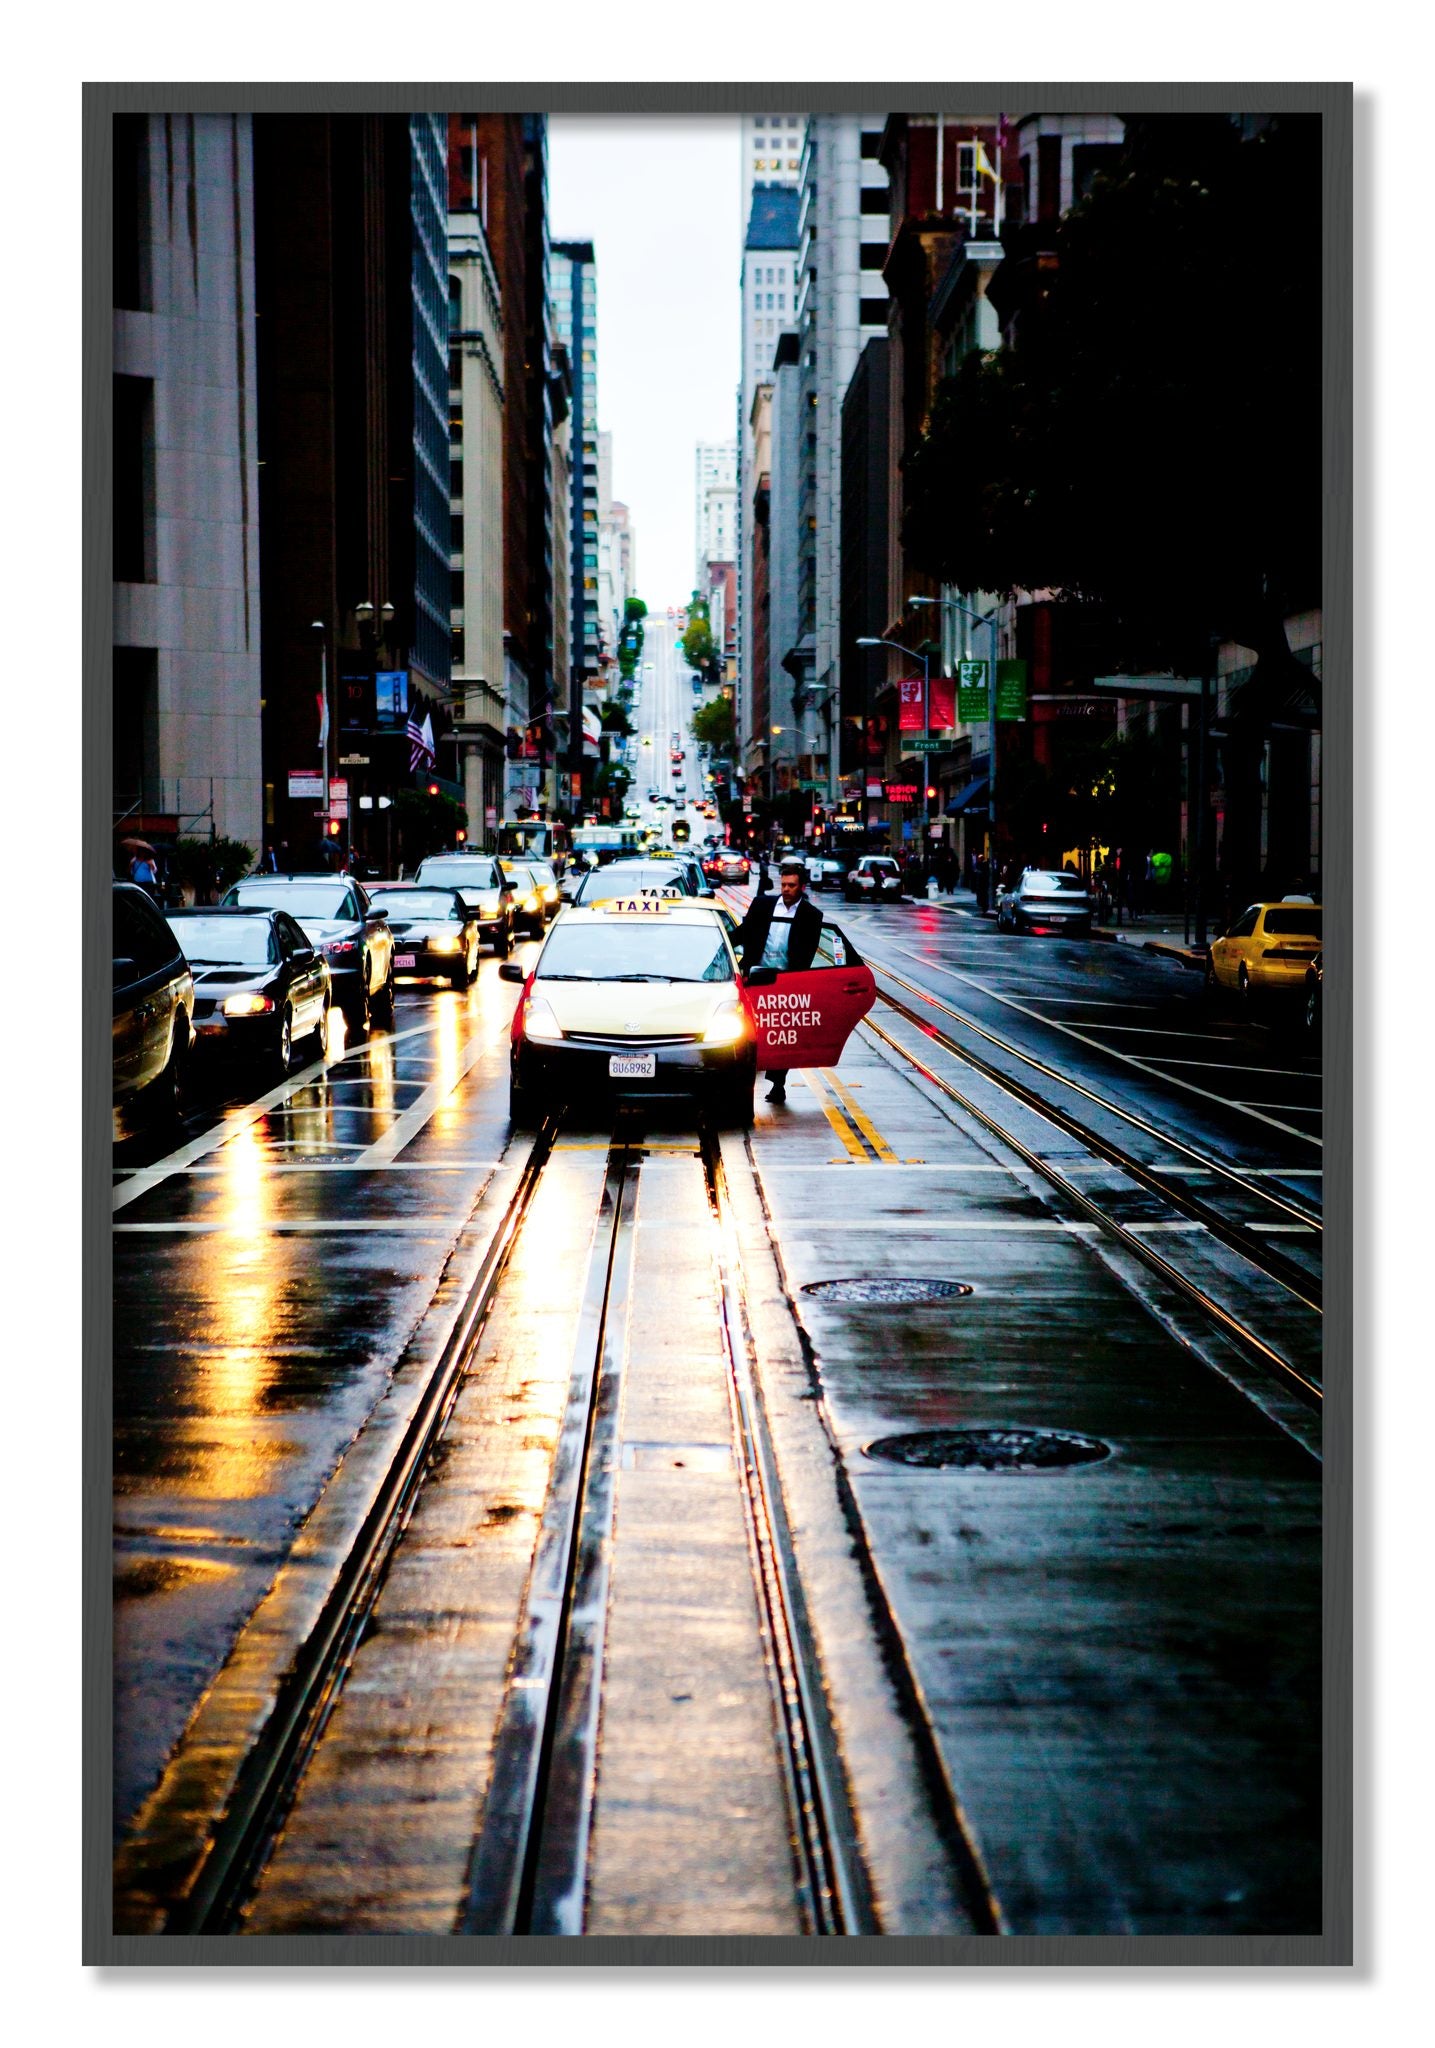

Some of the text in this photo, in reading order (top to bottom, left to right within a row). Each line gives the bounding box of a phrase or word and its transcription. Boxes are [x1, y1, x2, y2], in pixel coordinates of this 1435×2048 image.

[914, 741, 940, 750] Front
[885, 784, 918, 794] TADICH
[889, 794, 913, 803] GRILL
[640, 889, 676, 898] TAXI
[616, 901, 660, 912] TAXI
[757, 993, 811, 1010] ARROW
[766, 1029, 798, 1046] CAB
[612, 1062, 652, 1074] 8U68982
